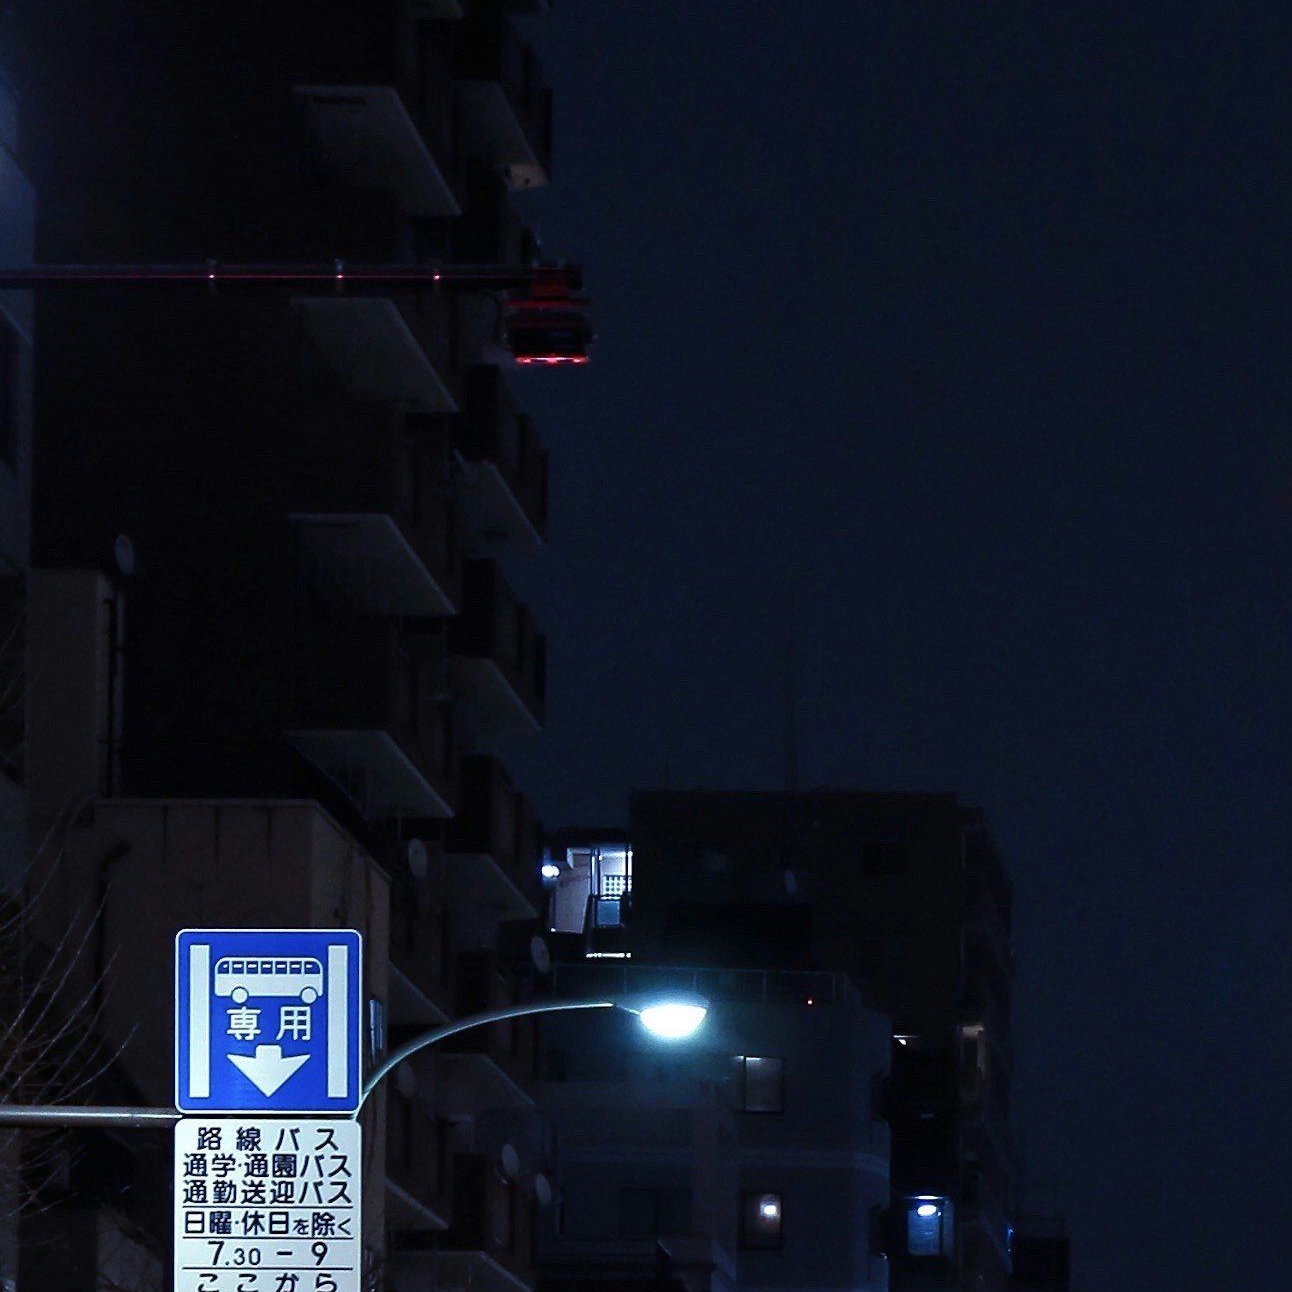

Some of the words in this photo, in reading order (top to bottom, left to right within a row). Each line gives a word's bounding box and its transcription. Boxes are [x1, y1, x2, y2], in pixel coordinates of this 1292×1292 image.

[226, 1006, 312, 1041] 専用
[198, 1127, 339, 1152] 路線バス
[183, 1181, 352, 1205] 通勤送迎バス
